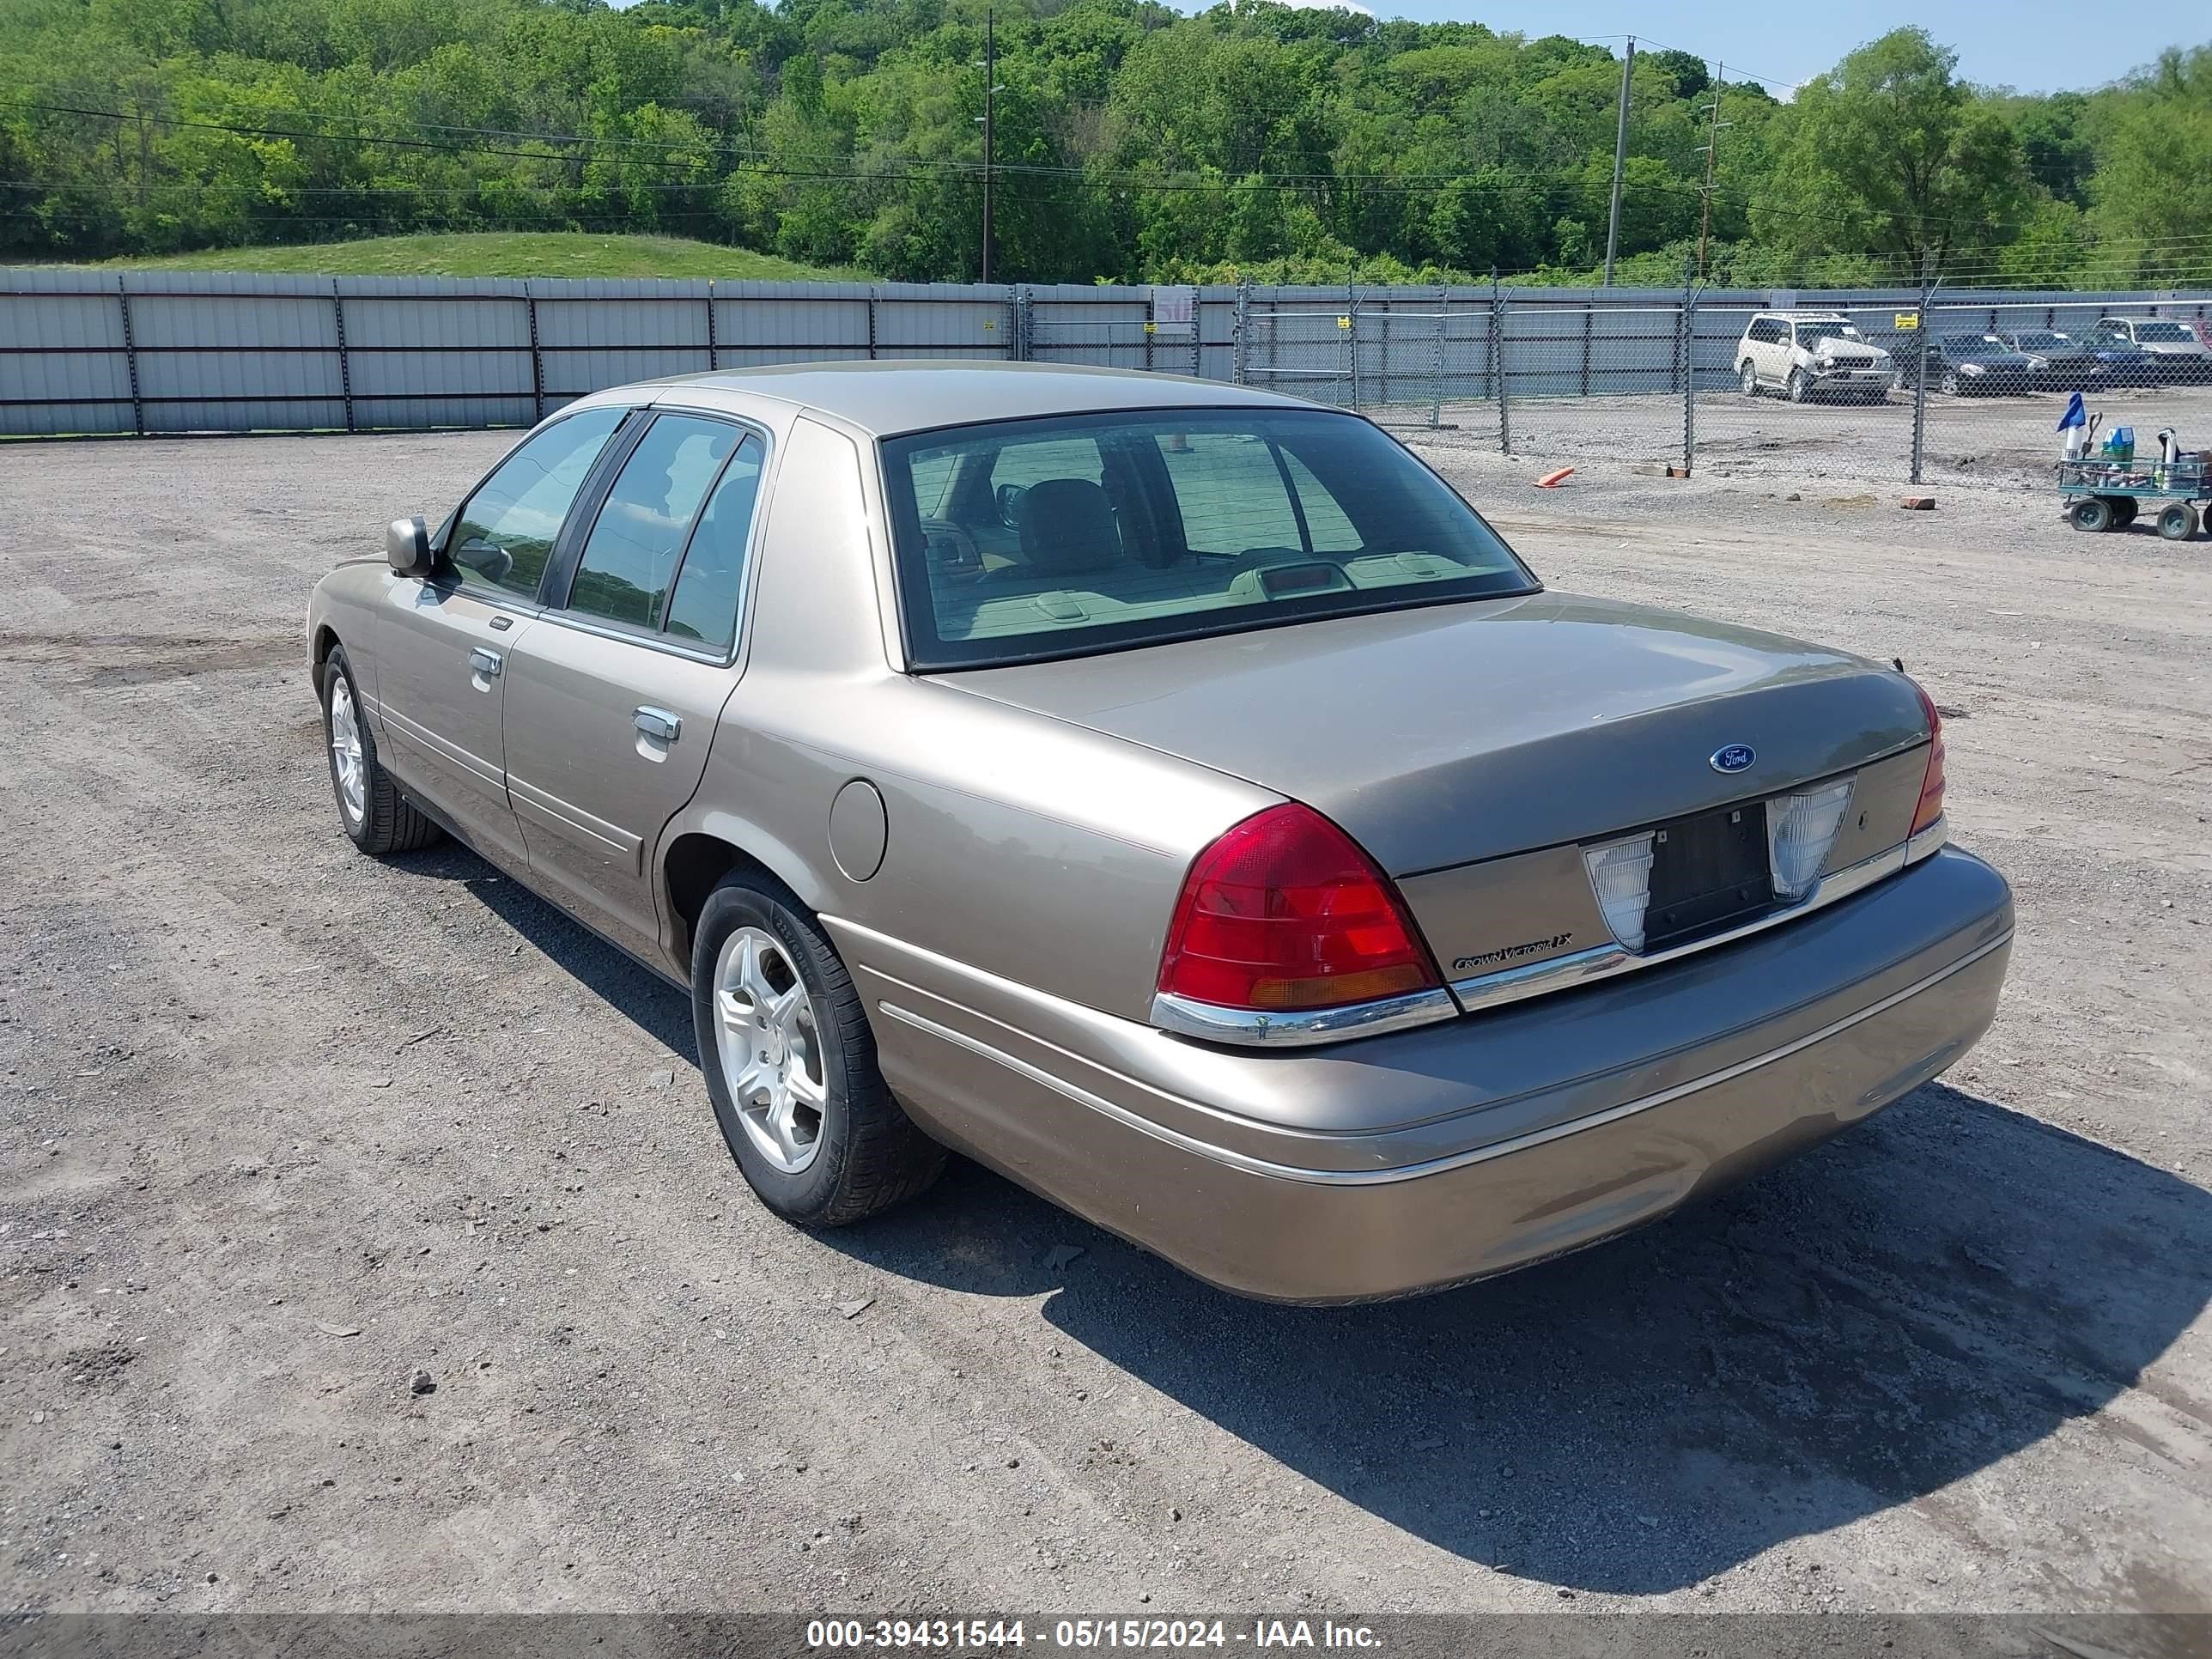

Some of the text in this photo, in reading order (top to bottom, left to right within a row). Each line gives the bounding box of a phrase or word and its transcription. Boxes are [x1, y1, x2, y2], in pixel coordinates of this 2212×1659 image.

[1725, 749, 1747, 767] Ford
[1454, 932, 1573, 970] CROWN VICTORIA LX
